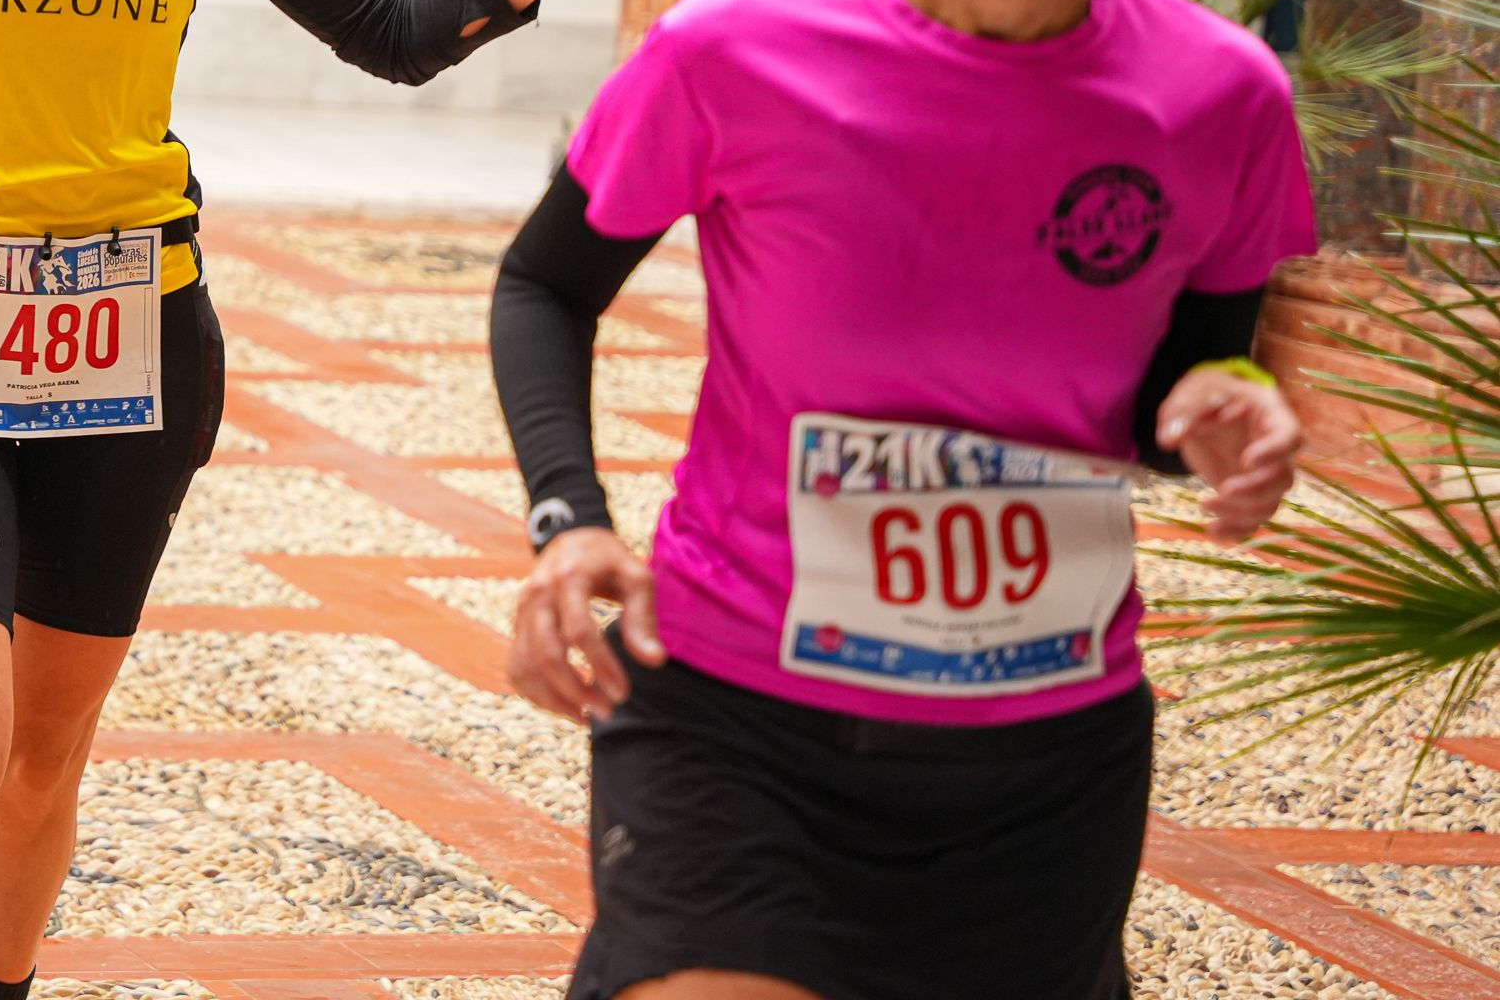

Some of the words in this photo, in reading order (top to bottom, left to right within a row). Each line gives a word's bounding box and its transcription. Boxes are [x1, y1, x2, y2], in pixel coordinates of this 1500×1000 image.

[104, 254, 148, 269] populares
[76, 273, 100, 291] 2026
[870, 502, 1050, 611] 609
